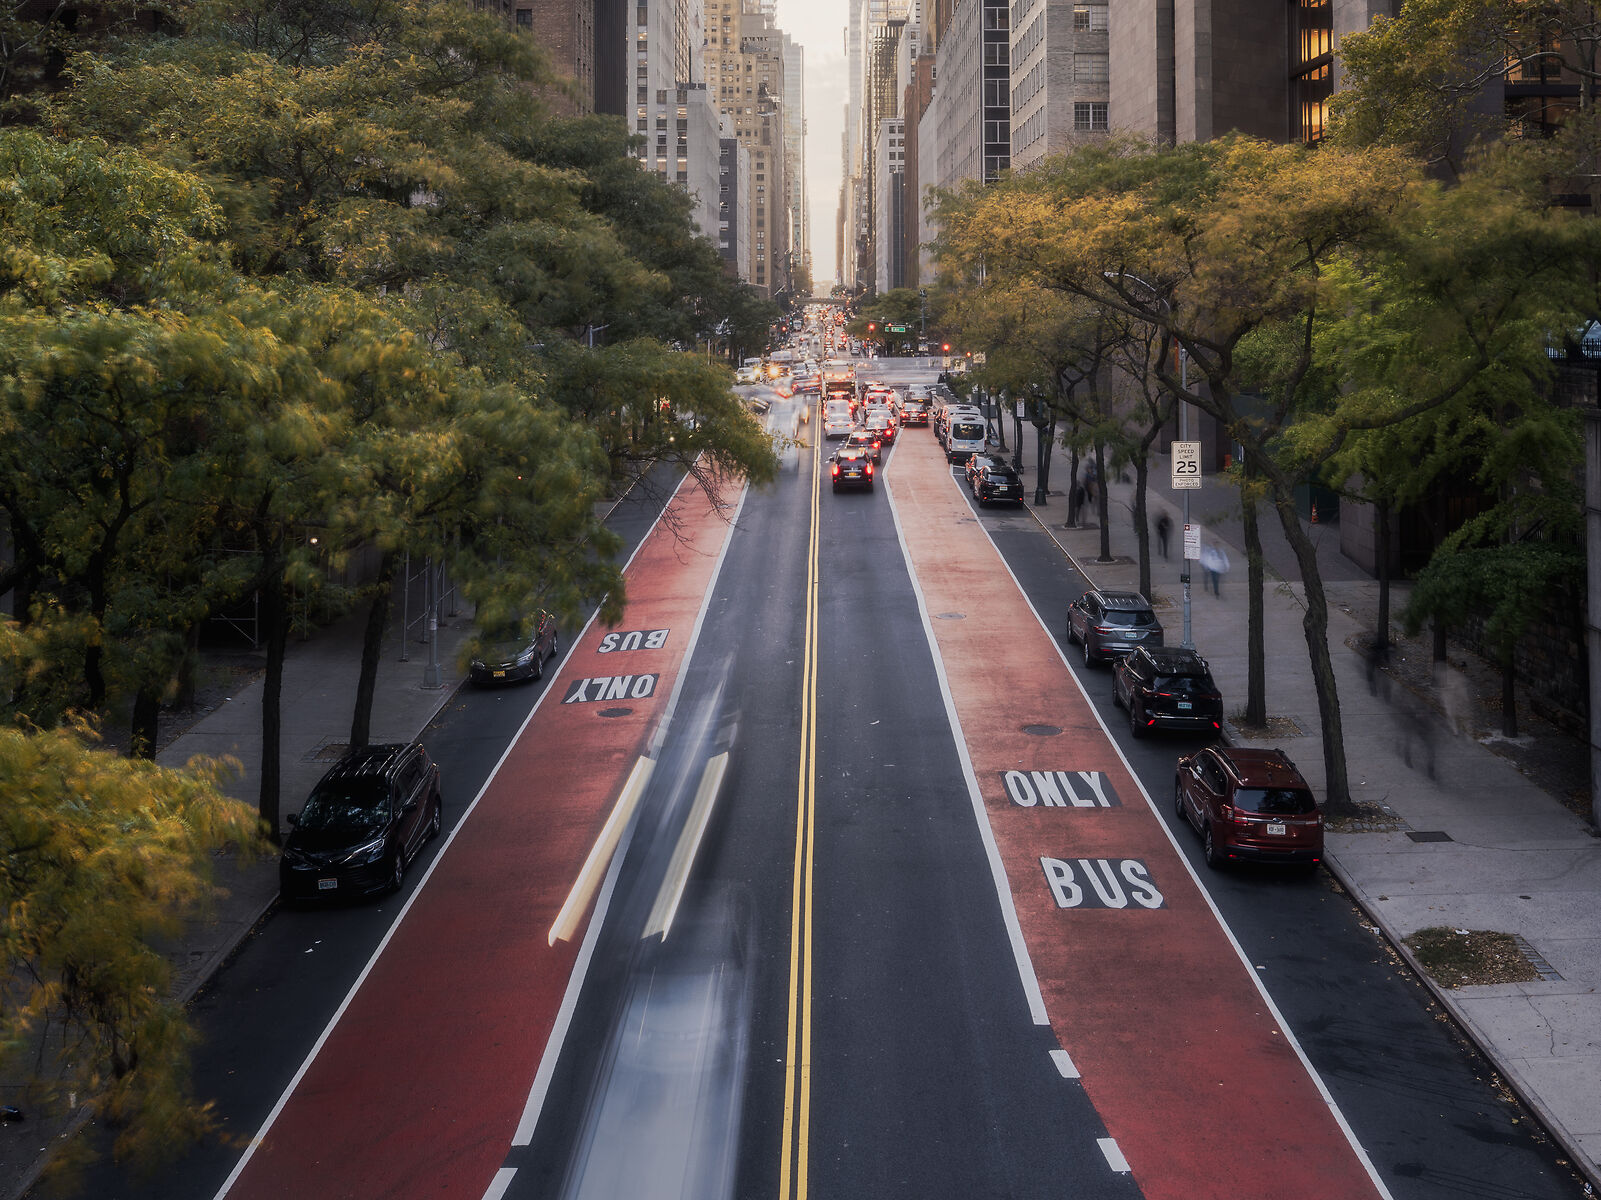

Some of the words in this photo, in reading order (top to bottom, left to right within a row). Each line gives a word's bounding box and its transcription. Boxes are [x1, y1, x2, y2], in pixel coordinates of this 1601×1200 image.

[1176, 461, 1197, 473] 25
[598, 629, 669, 653] BUS
[565, 674, 655, 704] ONLY
[1004, 770, 1111, 807] ONLY
[1040, 856, 1164, 909] BUS
